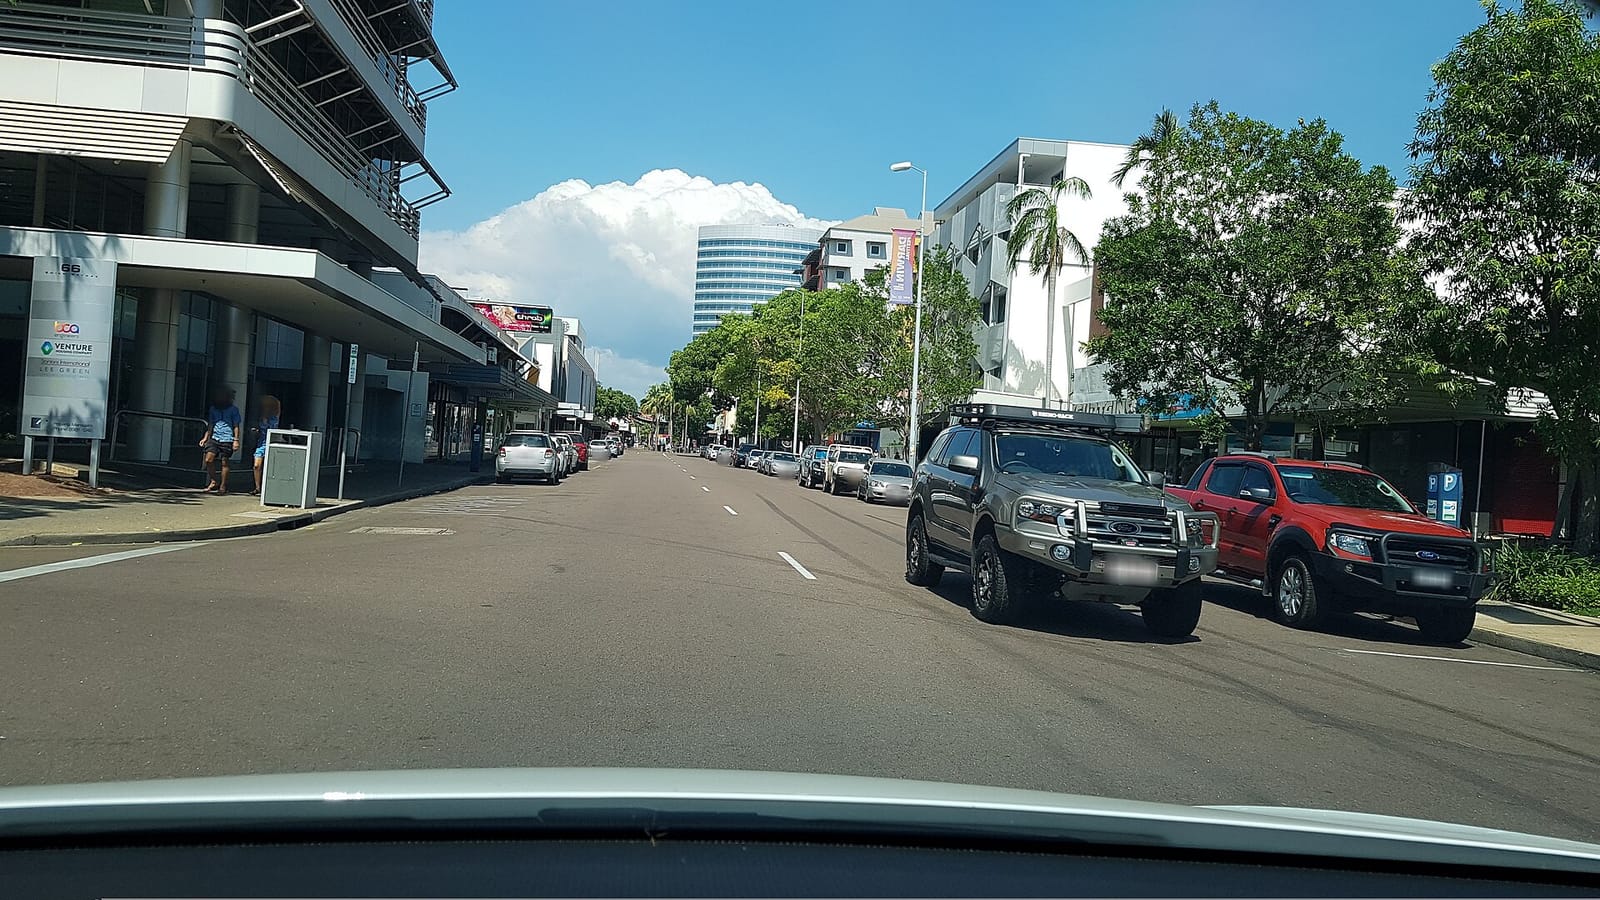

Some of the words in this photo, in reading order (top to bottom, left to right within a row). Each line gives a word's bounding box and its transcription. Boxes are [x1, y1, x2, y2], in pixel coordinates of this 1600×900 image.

[61, 263, 81, 273] 66
[516, 314, 543, 322] throb
[54, 320, 80, 334] bca
[55, 343, 93, 351] VENTURE
[1445, 474, 1454, 488] P
